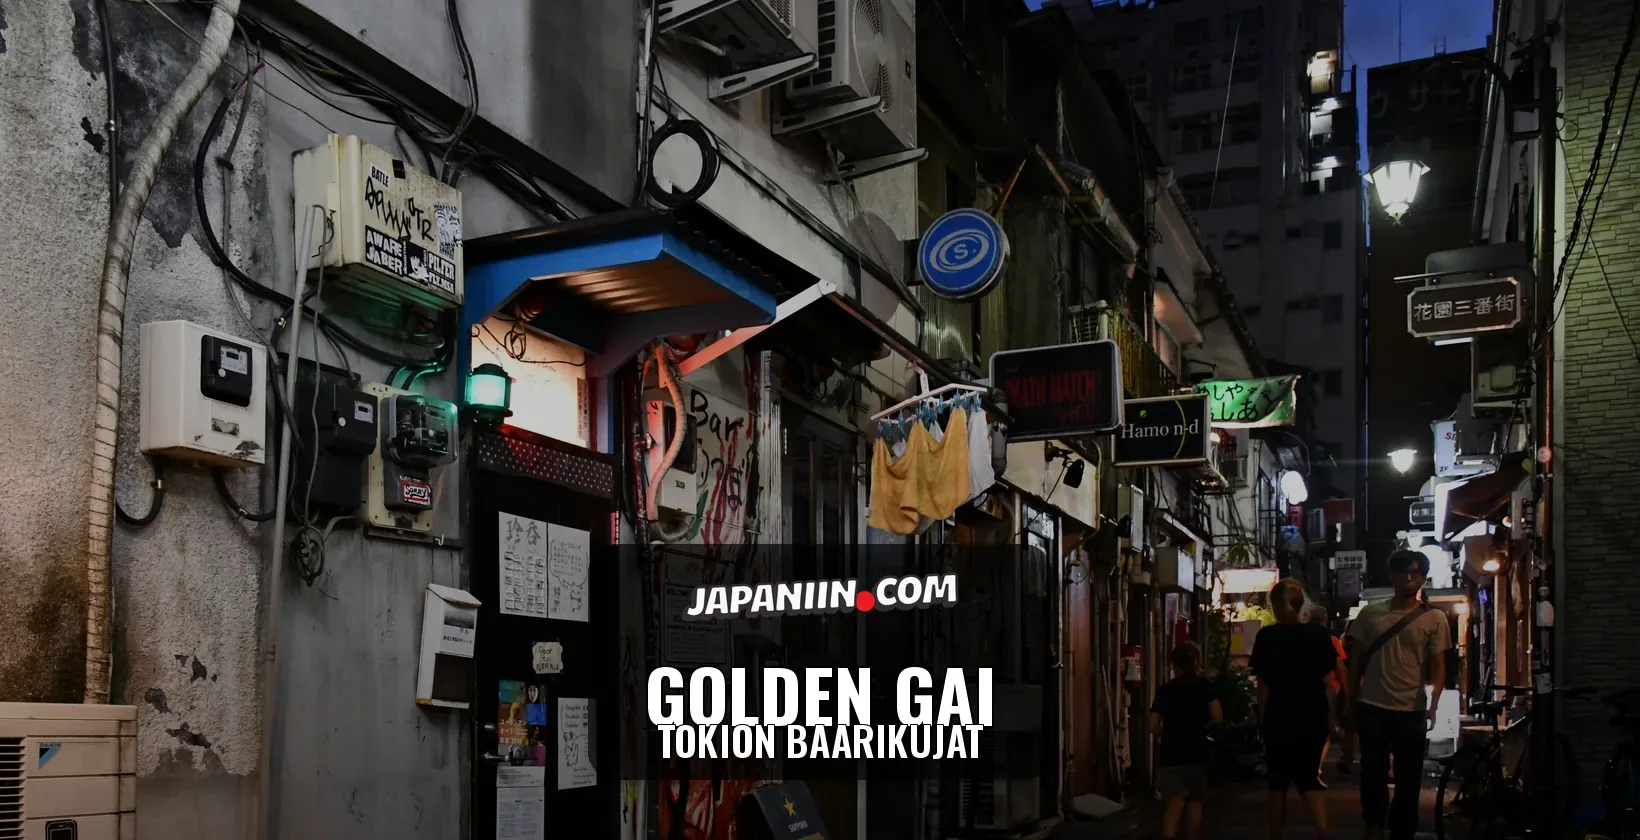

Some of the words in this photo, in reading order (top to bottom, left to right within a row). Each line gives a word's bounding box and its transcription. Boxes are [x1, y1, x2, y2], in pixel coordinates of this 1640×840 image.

[371, 165, 389, 188] BATLE
[366, 229, 402, 258] AWARE
[366, 246, 403, 276] JABER
[1413, 293, 1515, 322] 花園三番街
[690, 388, 744, 446] Bar
[1121, 423, 1169, 439] Hamo
[536, 663, 559, 672] NARNIA
